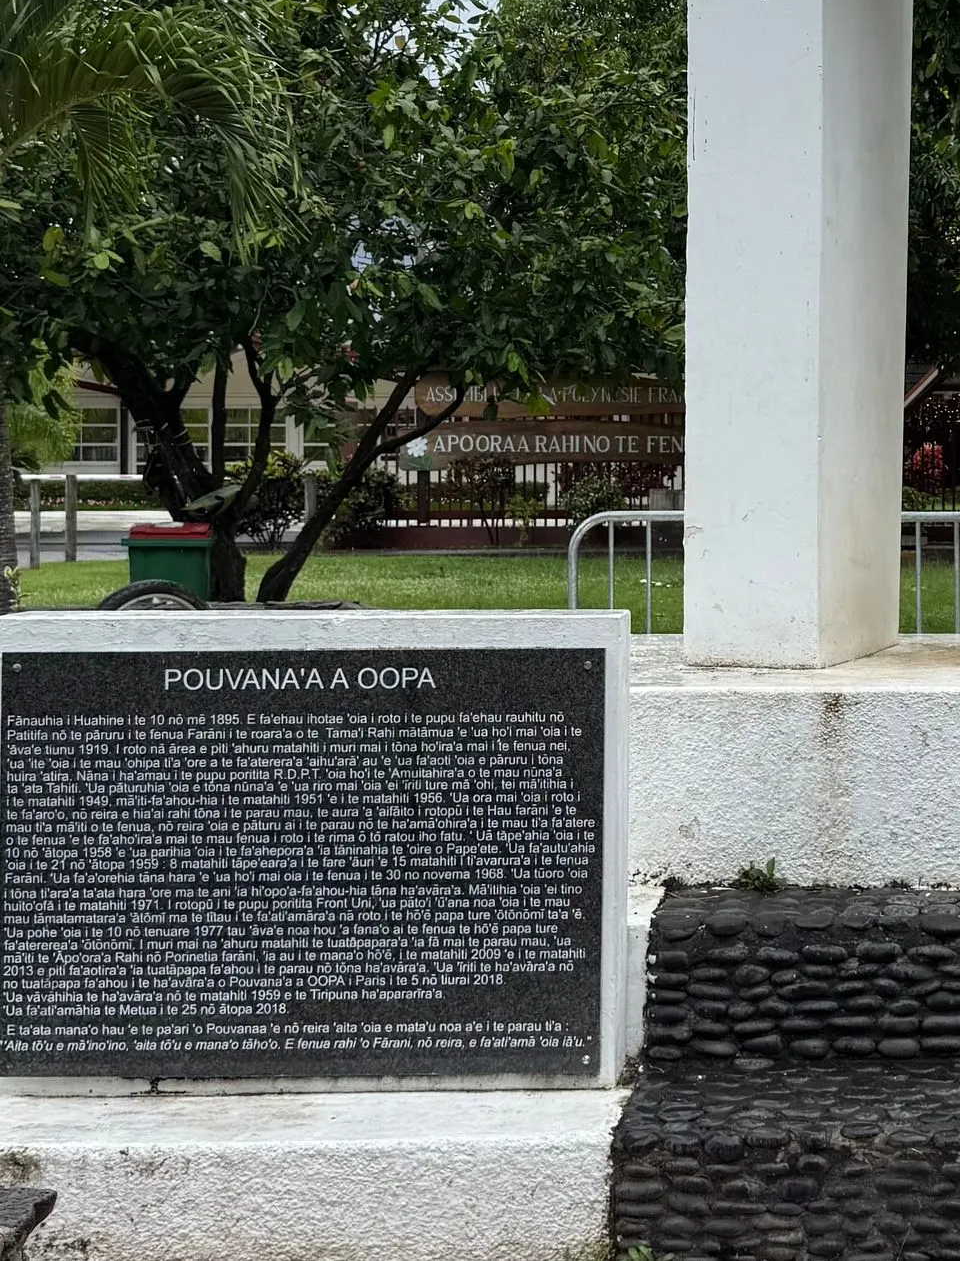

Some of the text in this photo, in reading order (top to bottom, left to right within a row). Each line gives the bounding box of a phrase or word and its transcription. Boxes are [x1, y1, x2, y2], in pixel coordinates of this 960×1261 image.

[534, 435, 580, 453] RAHI
[583, 435, 610, 453] NO
[614, 435, 639, 453] TE
[164, 667, 436, 690] POUVANA'A A OOPA
[73, 713, 124, 726] Huahine
[134, 713, 146, 726] te
[150, 713, 165, 726] 10
[210, 712, 243, 725] 1895.
[246, 712, 256, 725] E
[306, 712, 343, 725] ihotae
[377, 711, 401, 724] roto
[410, 711, 422, 724] te
[424, 714, 455, 726] pupu
[504, 711, 546, 724] rauhitu
[2, 979, 18, 989] no
[137, 975, 150, 988] te
[217, 978, 226, 988] o
[295, 977, 304, 987] a
[306, 974, 345, 987] OOPA
[354, 973, 386, 987] Paris
[395, 973, 408, 986] te
[410, 973, 419, 986] 5
[440, 973, 470, 986] tiurai
[472, 973, 507, 986] 2018.
[103, 1002, 116, 1015] te
[118, 1002, 157, 1015] Metua
[166, 1002, 178, 1015] te
[181, 1002, 197, 1015] 25
[255, 1001, 290, 1014] 2018.
